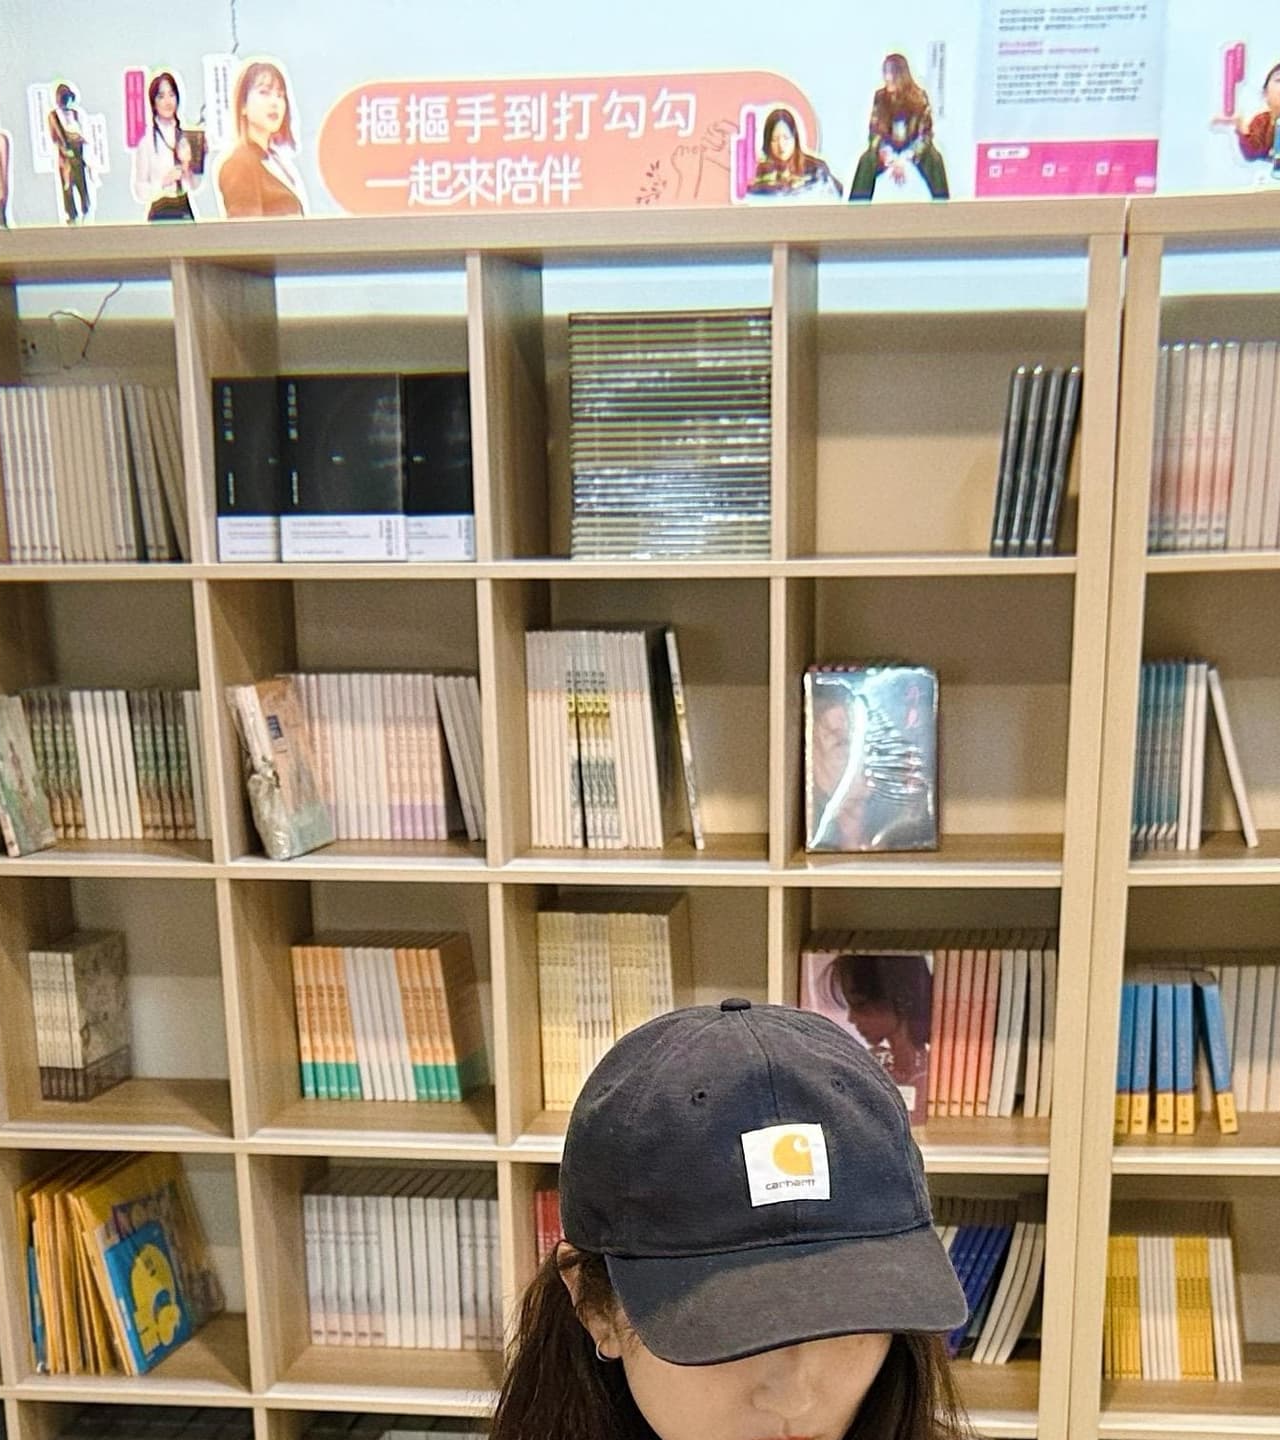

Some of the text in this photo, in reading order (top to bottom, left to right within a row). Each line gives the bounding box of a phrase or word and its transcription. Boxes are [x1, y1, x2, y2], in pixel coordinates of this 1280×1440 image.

[355, 88, 697, 147] 摳摳手到打勾勾
[365, 154, 584, 206] 一起來陪伴
[765, 1179, 815, 1191] carhartt
